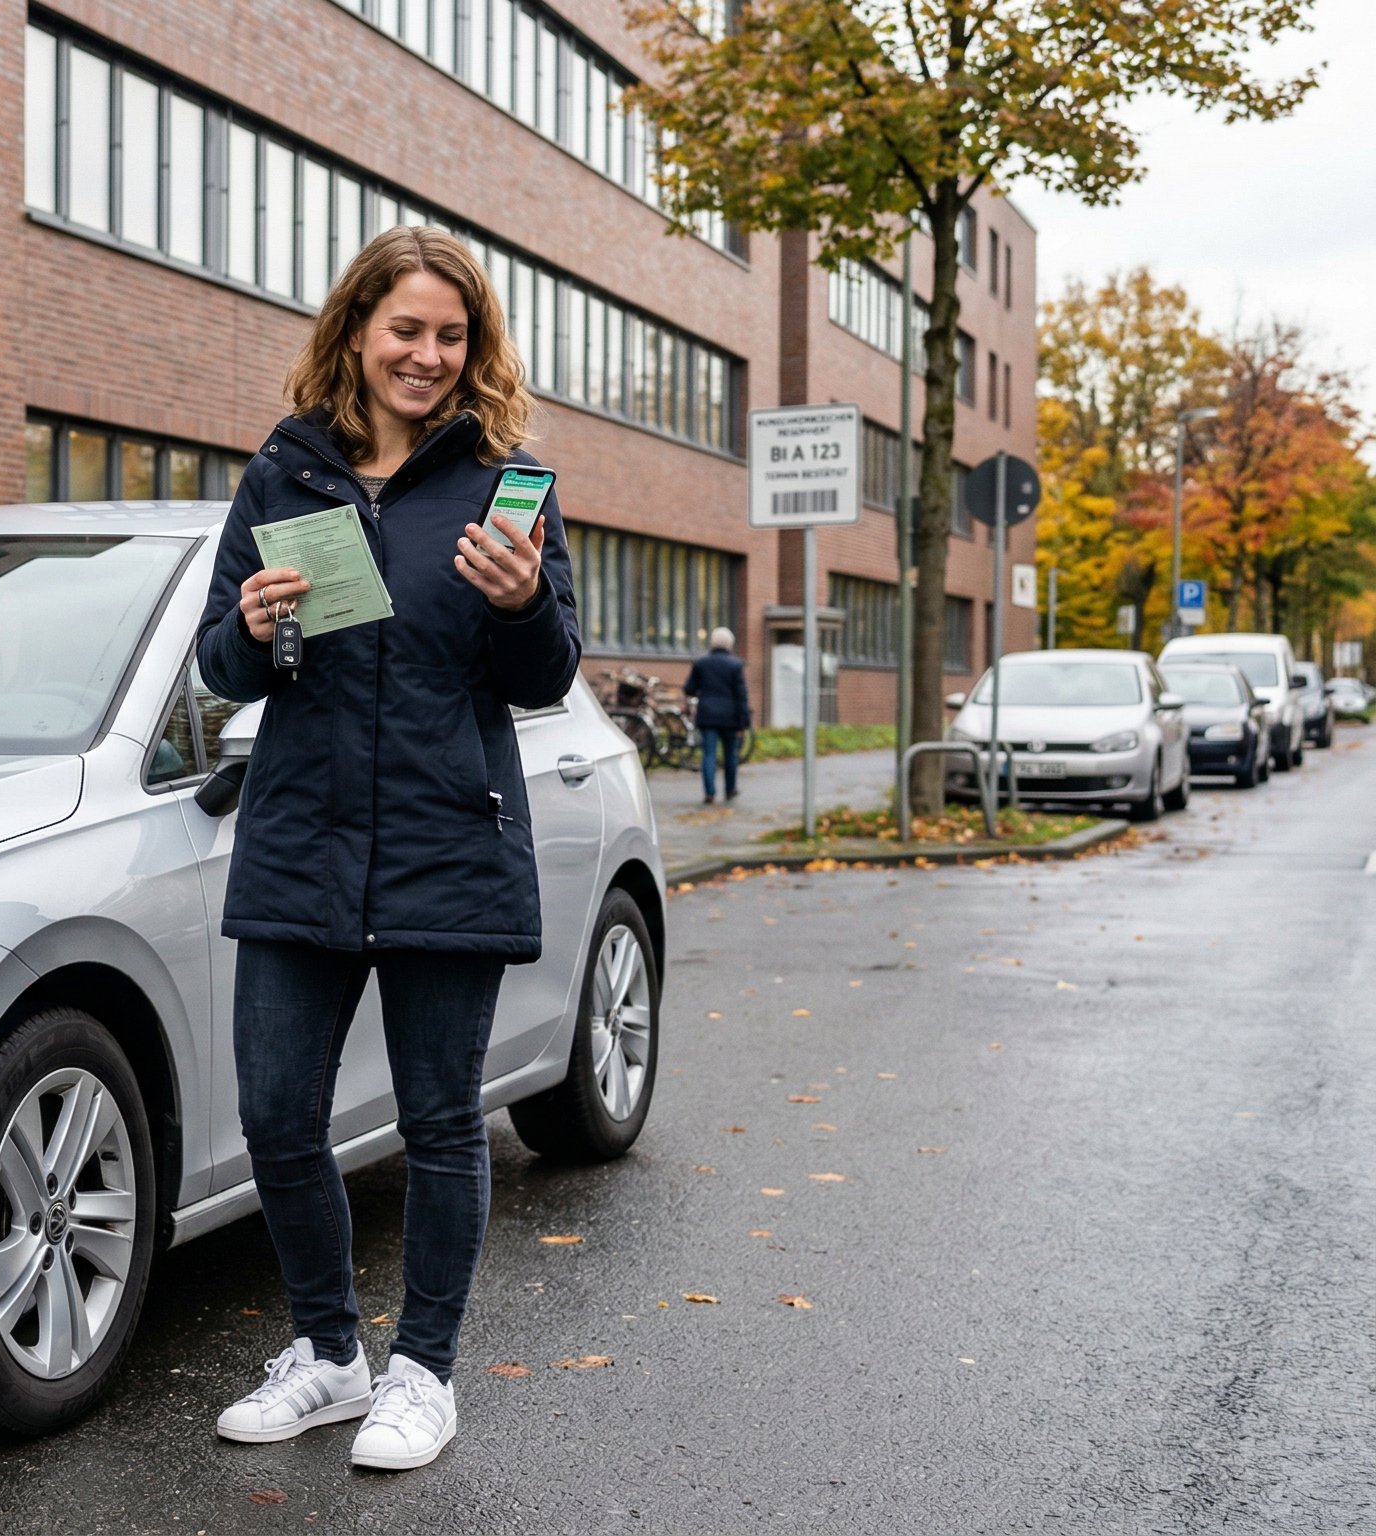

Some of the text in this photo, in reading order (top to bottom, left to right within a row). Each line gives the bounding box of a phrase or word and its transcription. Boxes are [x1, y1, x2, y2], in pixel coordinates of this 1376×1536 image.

[771, 441, 841, 462] BI A 123
[1183, 583, 1200, 605] P
